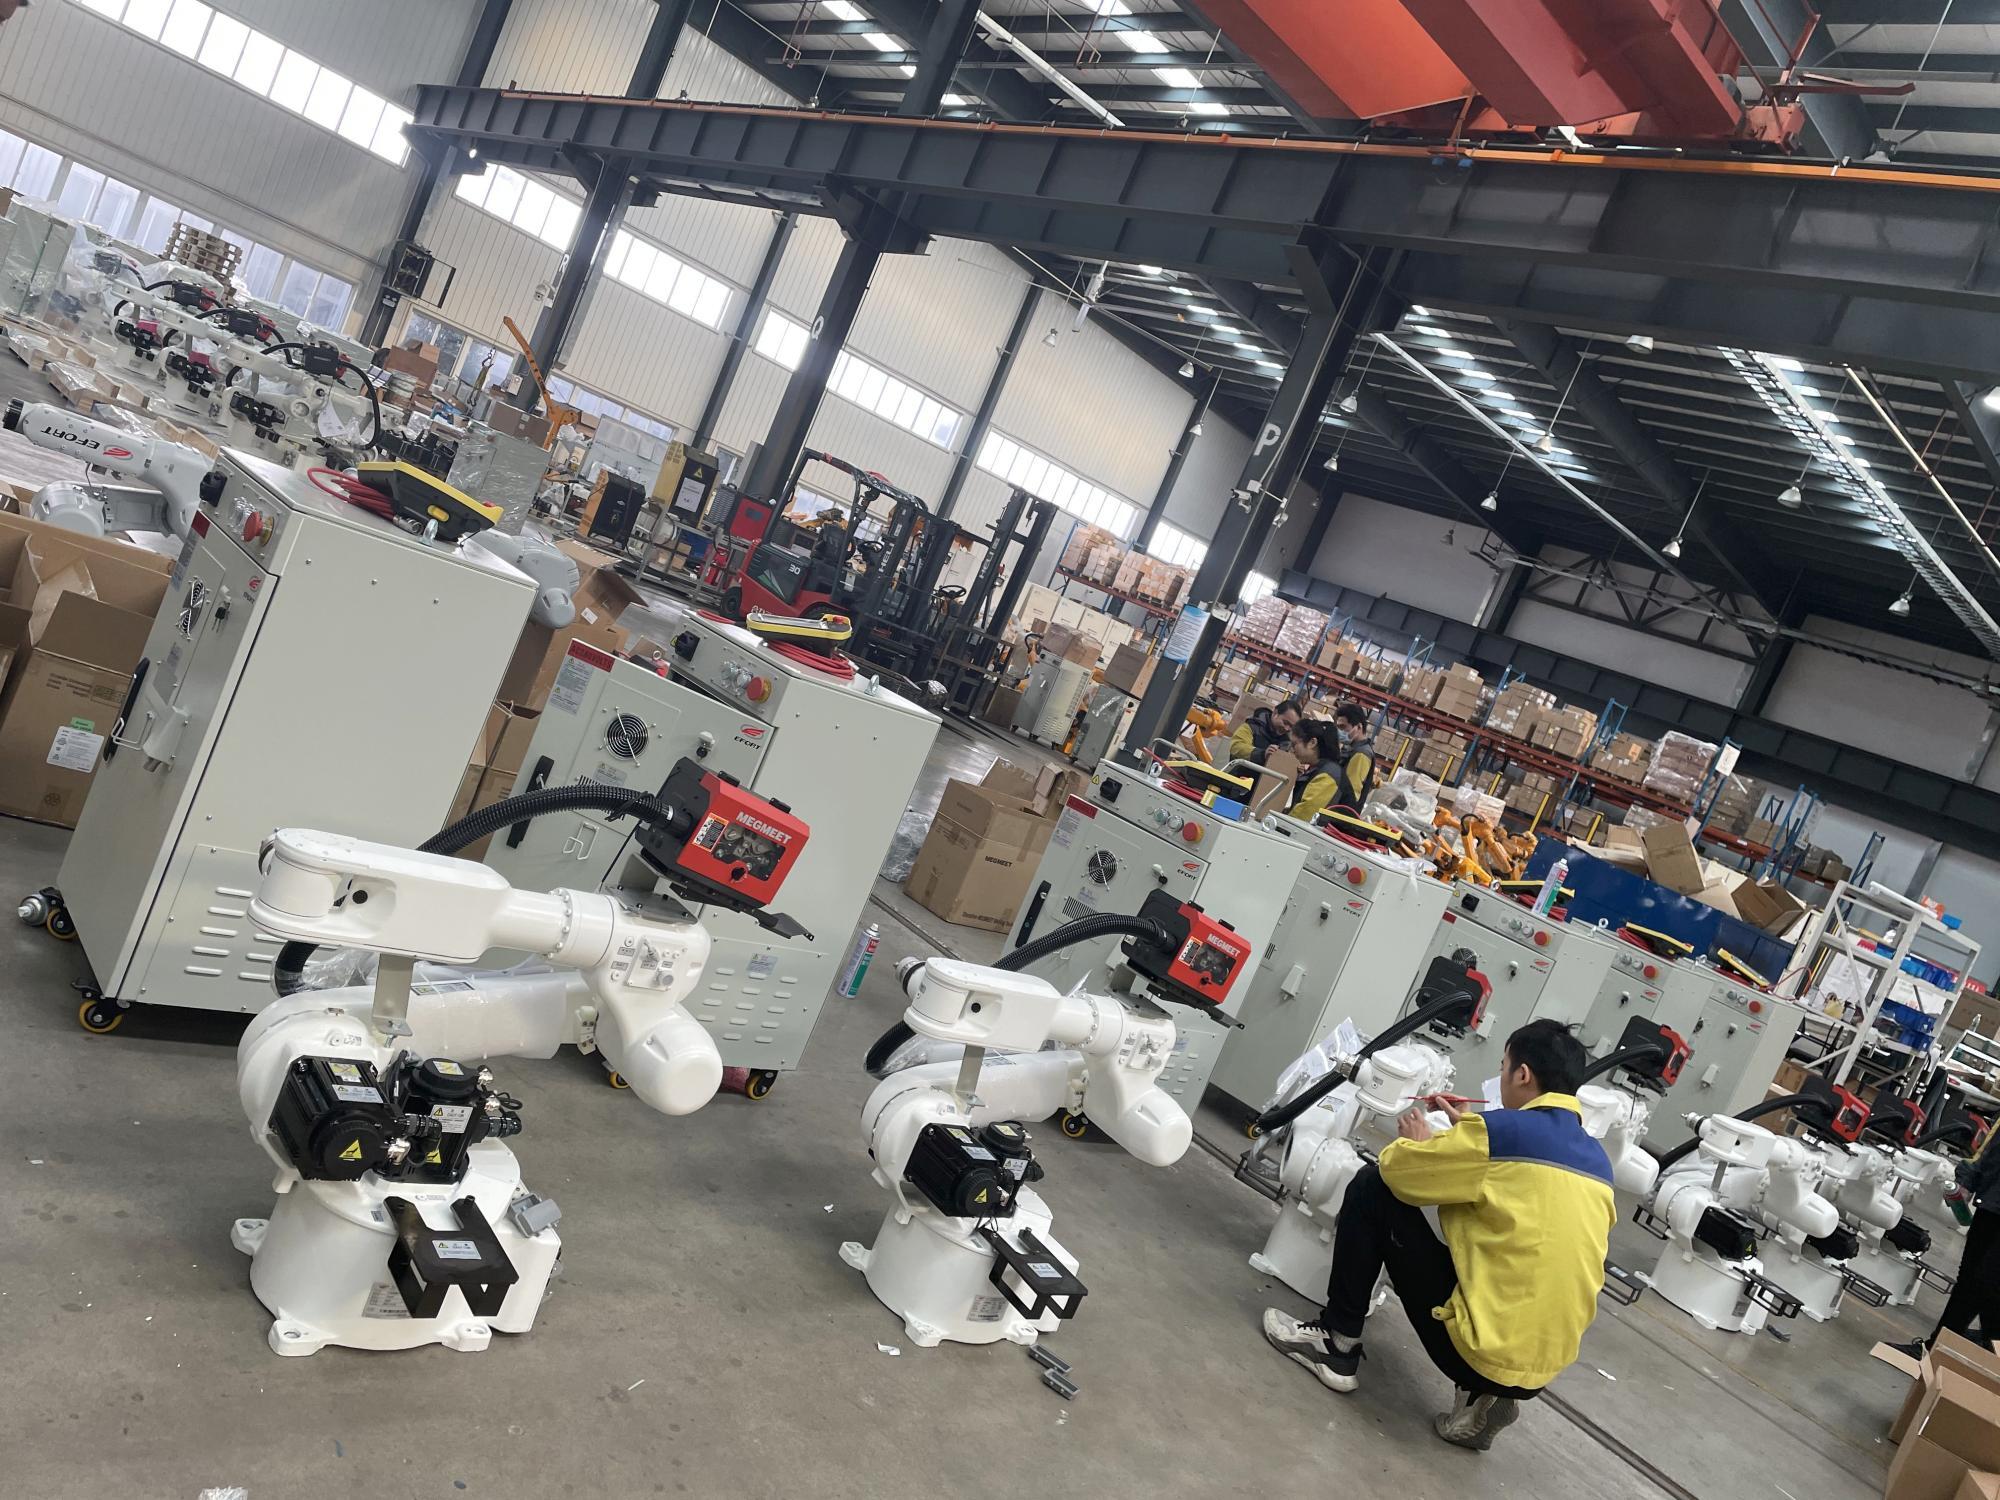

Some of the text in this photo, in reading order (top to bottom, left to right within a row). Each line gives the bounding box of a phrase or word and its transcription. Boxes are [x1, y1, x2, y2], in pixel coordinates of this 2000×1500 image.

[558, 253, 570, 273] R
[811, 315, 825, 340] Q
[40, 426, 101, 450] EFORT
[1253, 422, 1282, 456] P
[788, 563, 801, 575] 30
[878, 542, 895, 573] HELI
[733, 735, 761, 750] EFORT
[735, 811, 793, 844] MEGMEET
[984, 855, 1013, 868] MEGMEET
[1206, 933, 1241, 957] MEGMEET
